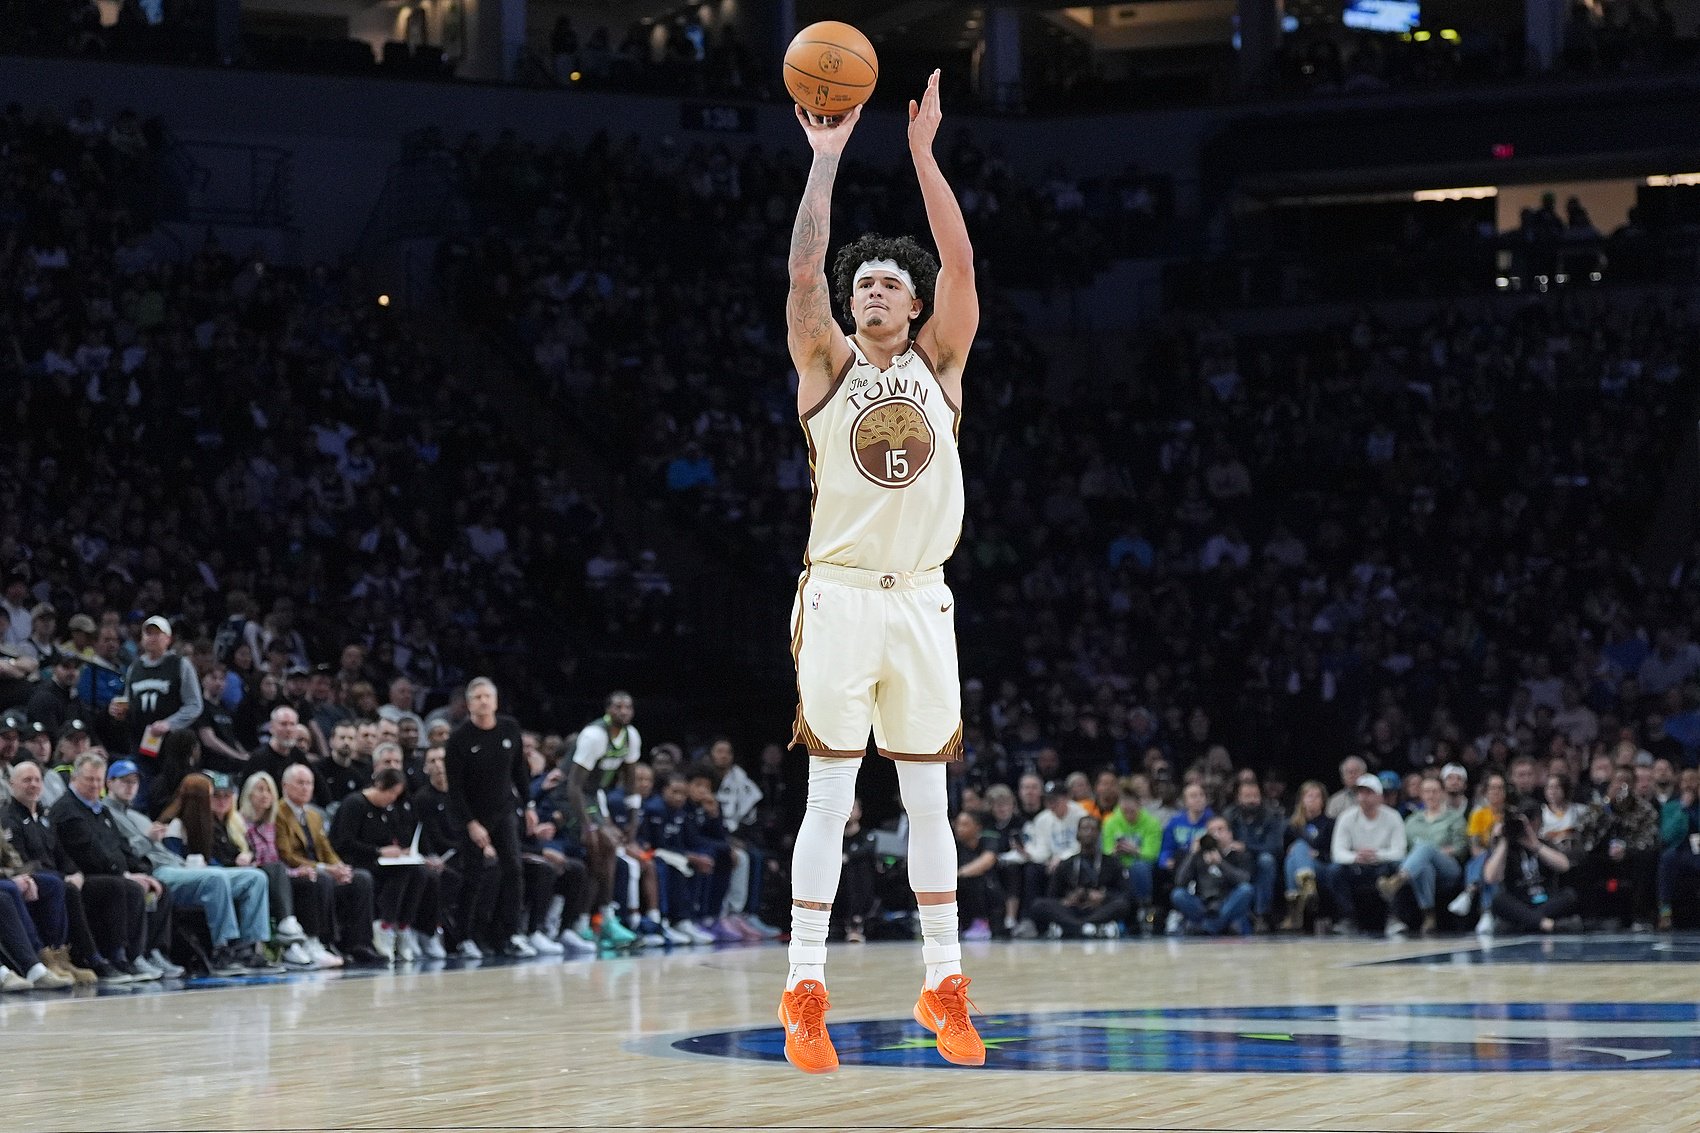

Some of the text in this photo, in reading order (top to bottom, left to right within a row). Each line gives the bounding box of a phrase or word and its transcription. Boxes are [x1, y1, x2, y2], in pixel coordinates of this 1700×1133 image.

[847, 376, 928, 410] TOWN
[849, 377, 869, 391] The
[885, 449, 909, 479] 15
